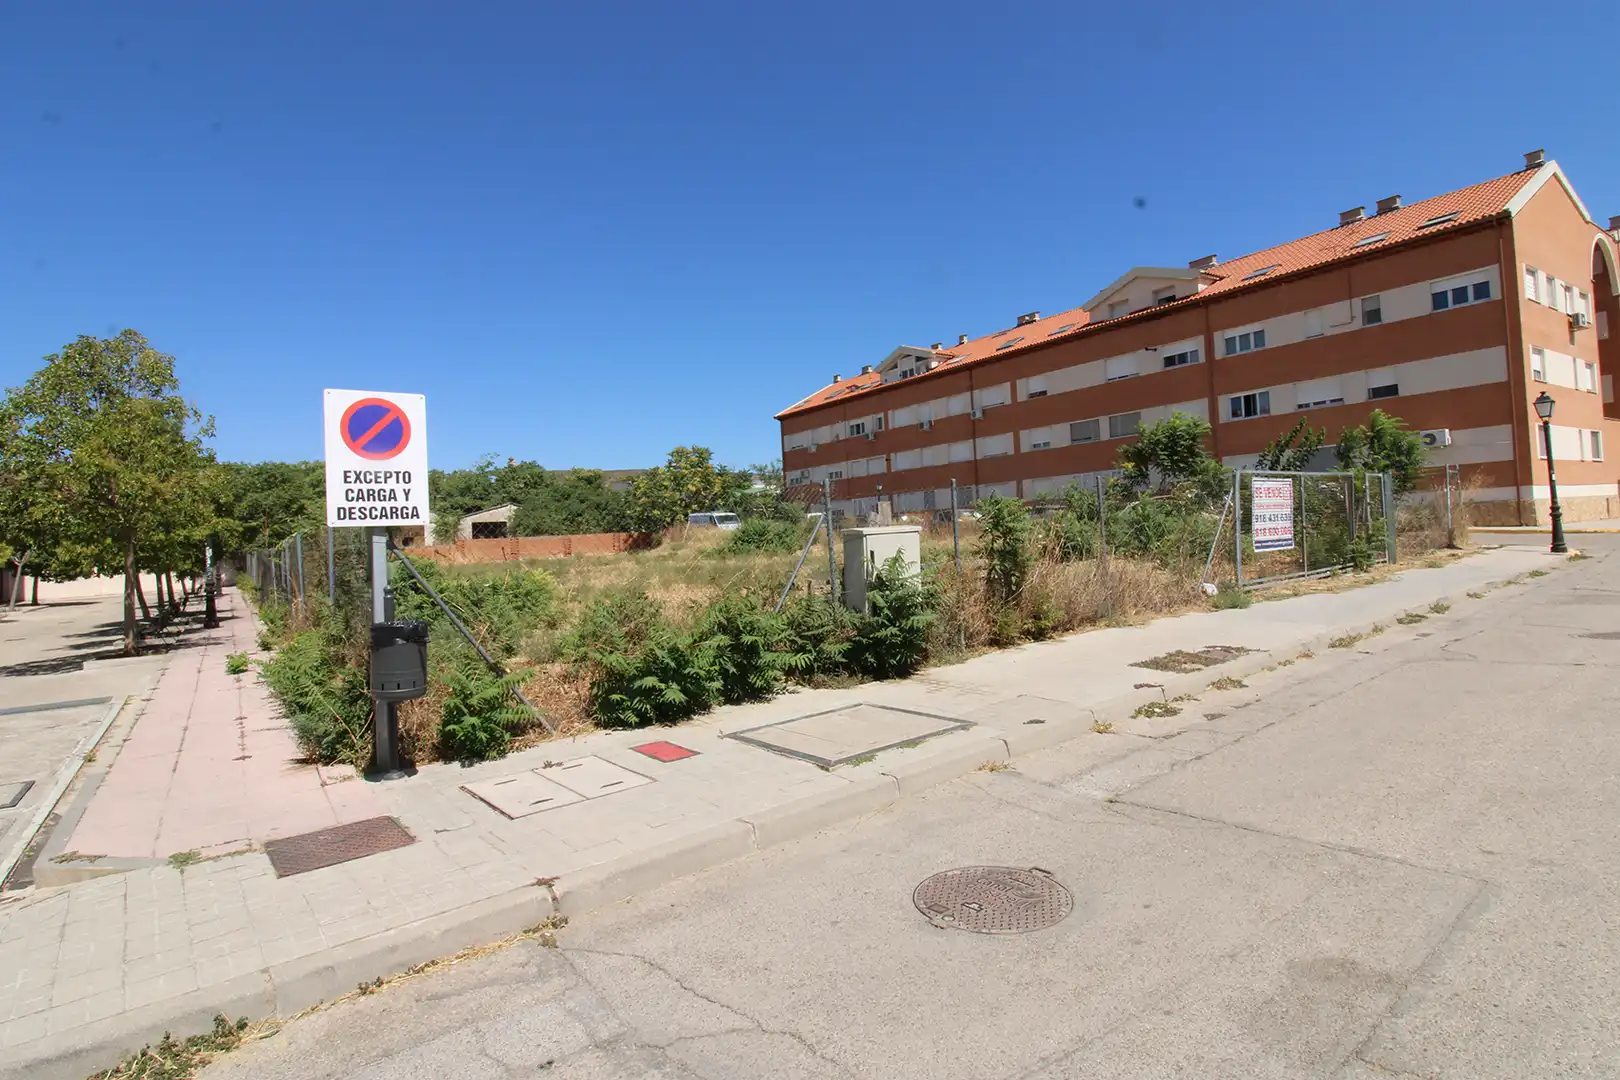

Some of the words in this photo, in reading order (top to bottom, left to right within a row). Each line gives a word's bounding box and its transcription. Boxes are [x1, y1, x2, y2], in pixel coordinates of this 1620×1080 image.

[343, 470, 412, 484] EXCEPTO
[345, 488, 397, 502] CARGA
[403, 488, 412, 502] Y
[337, 506, 420, 520] DESCARGA
